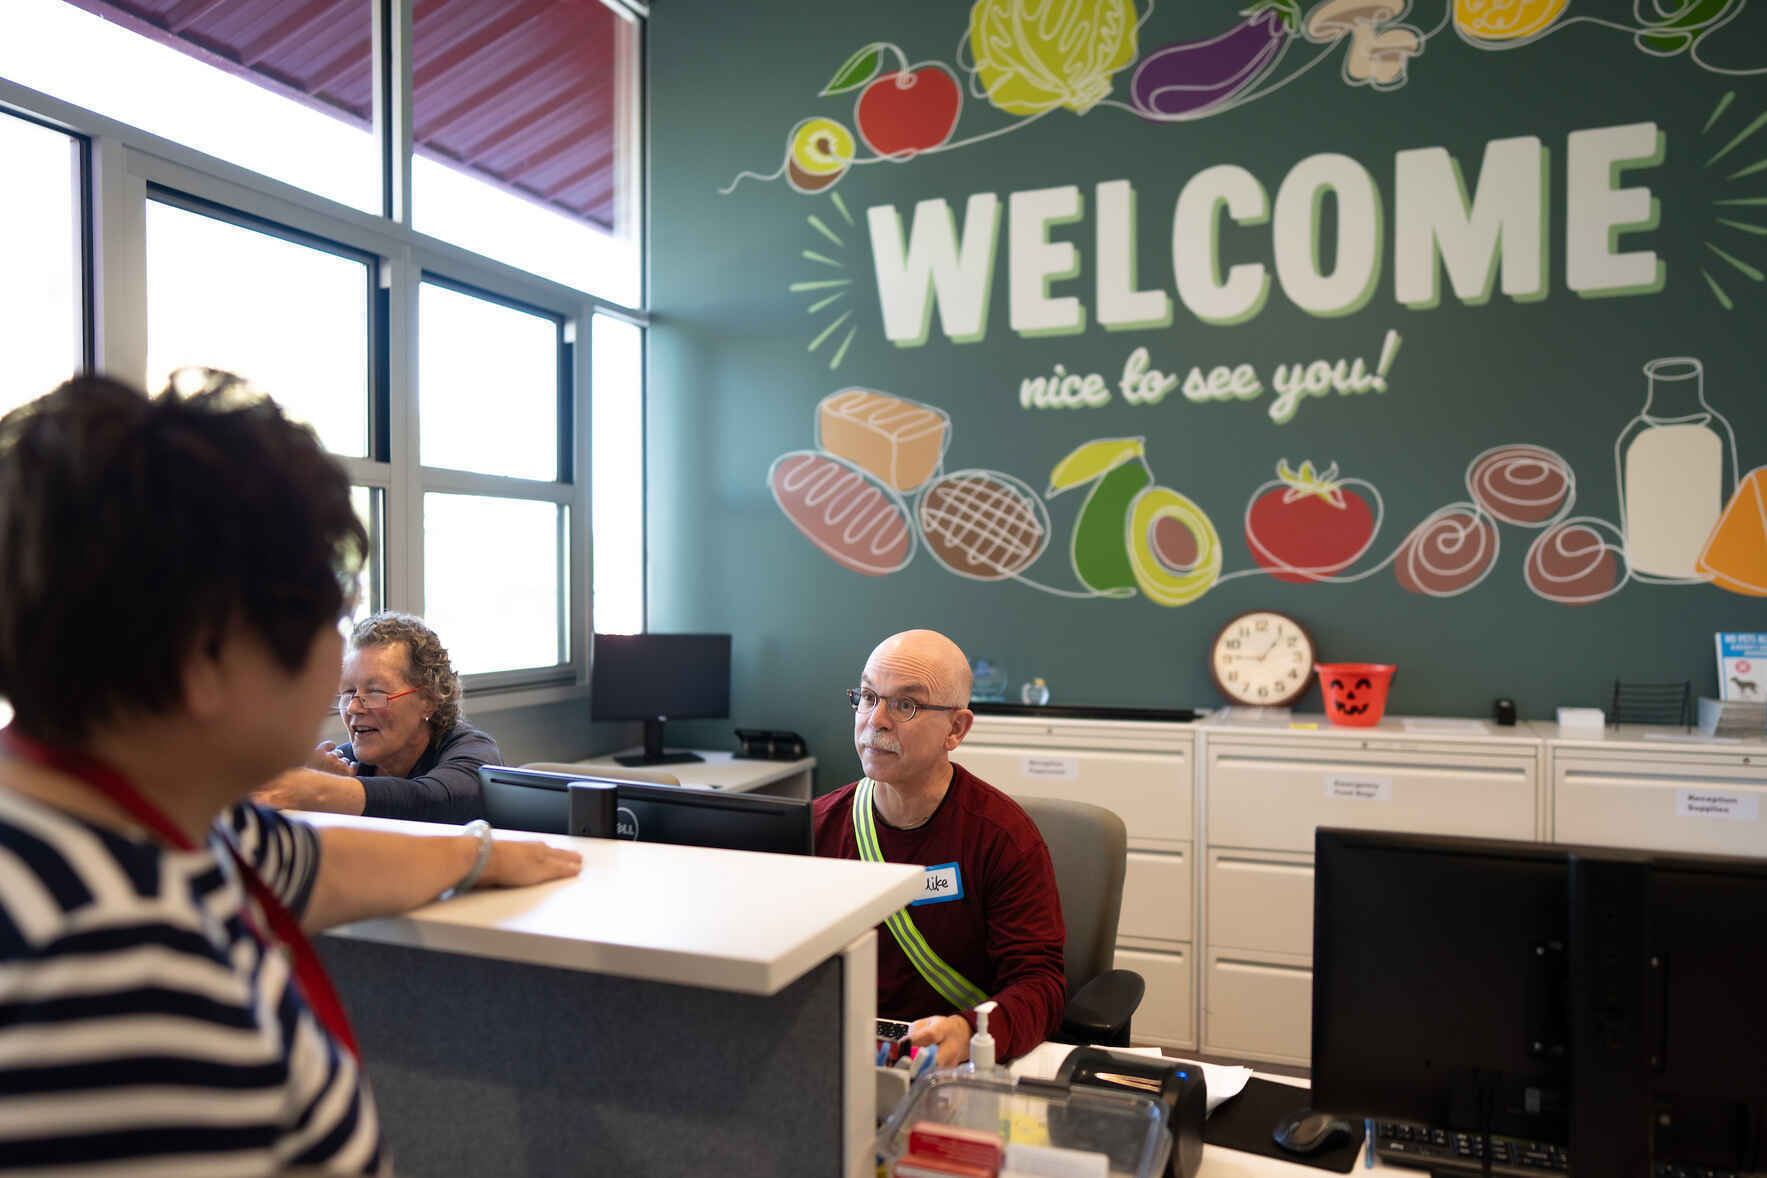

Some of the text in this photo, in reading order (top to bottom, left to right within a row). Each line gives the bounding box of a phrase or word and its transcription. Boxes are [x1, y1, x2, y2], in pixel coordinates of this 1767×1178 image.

[866, 121, 1667, 348] WELCOME
[1020, 328, 1402, 425] nice to see you!
[925, 874, 949, 892] ike
